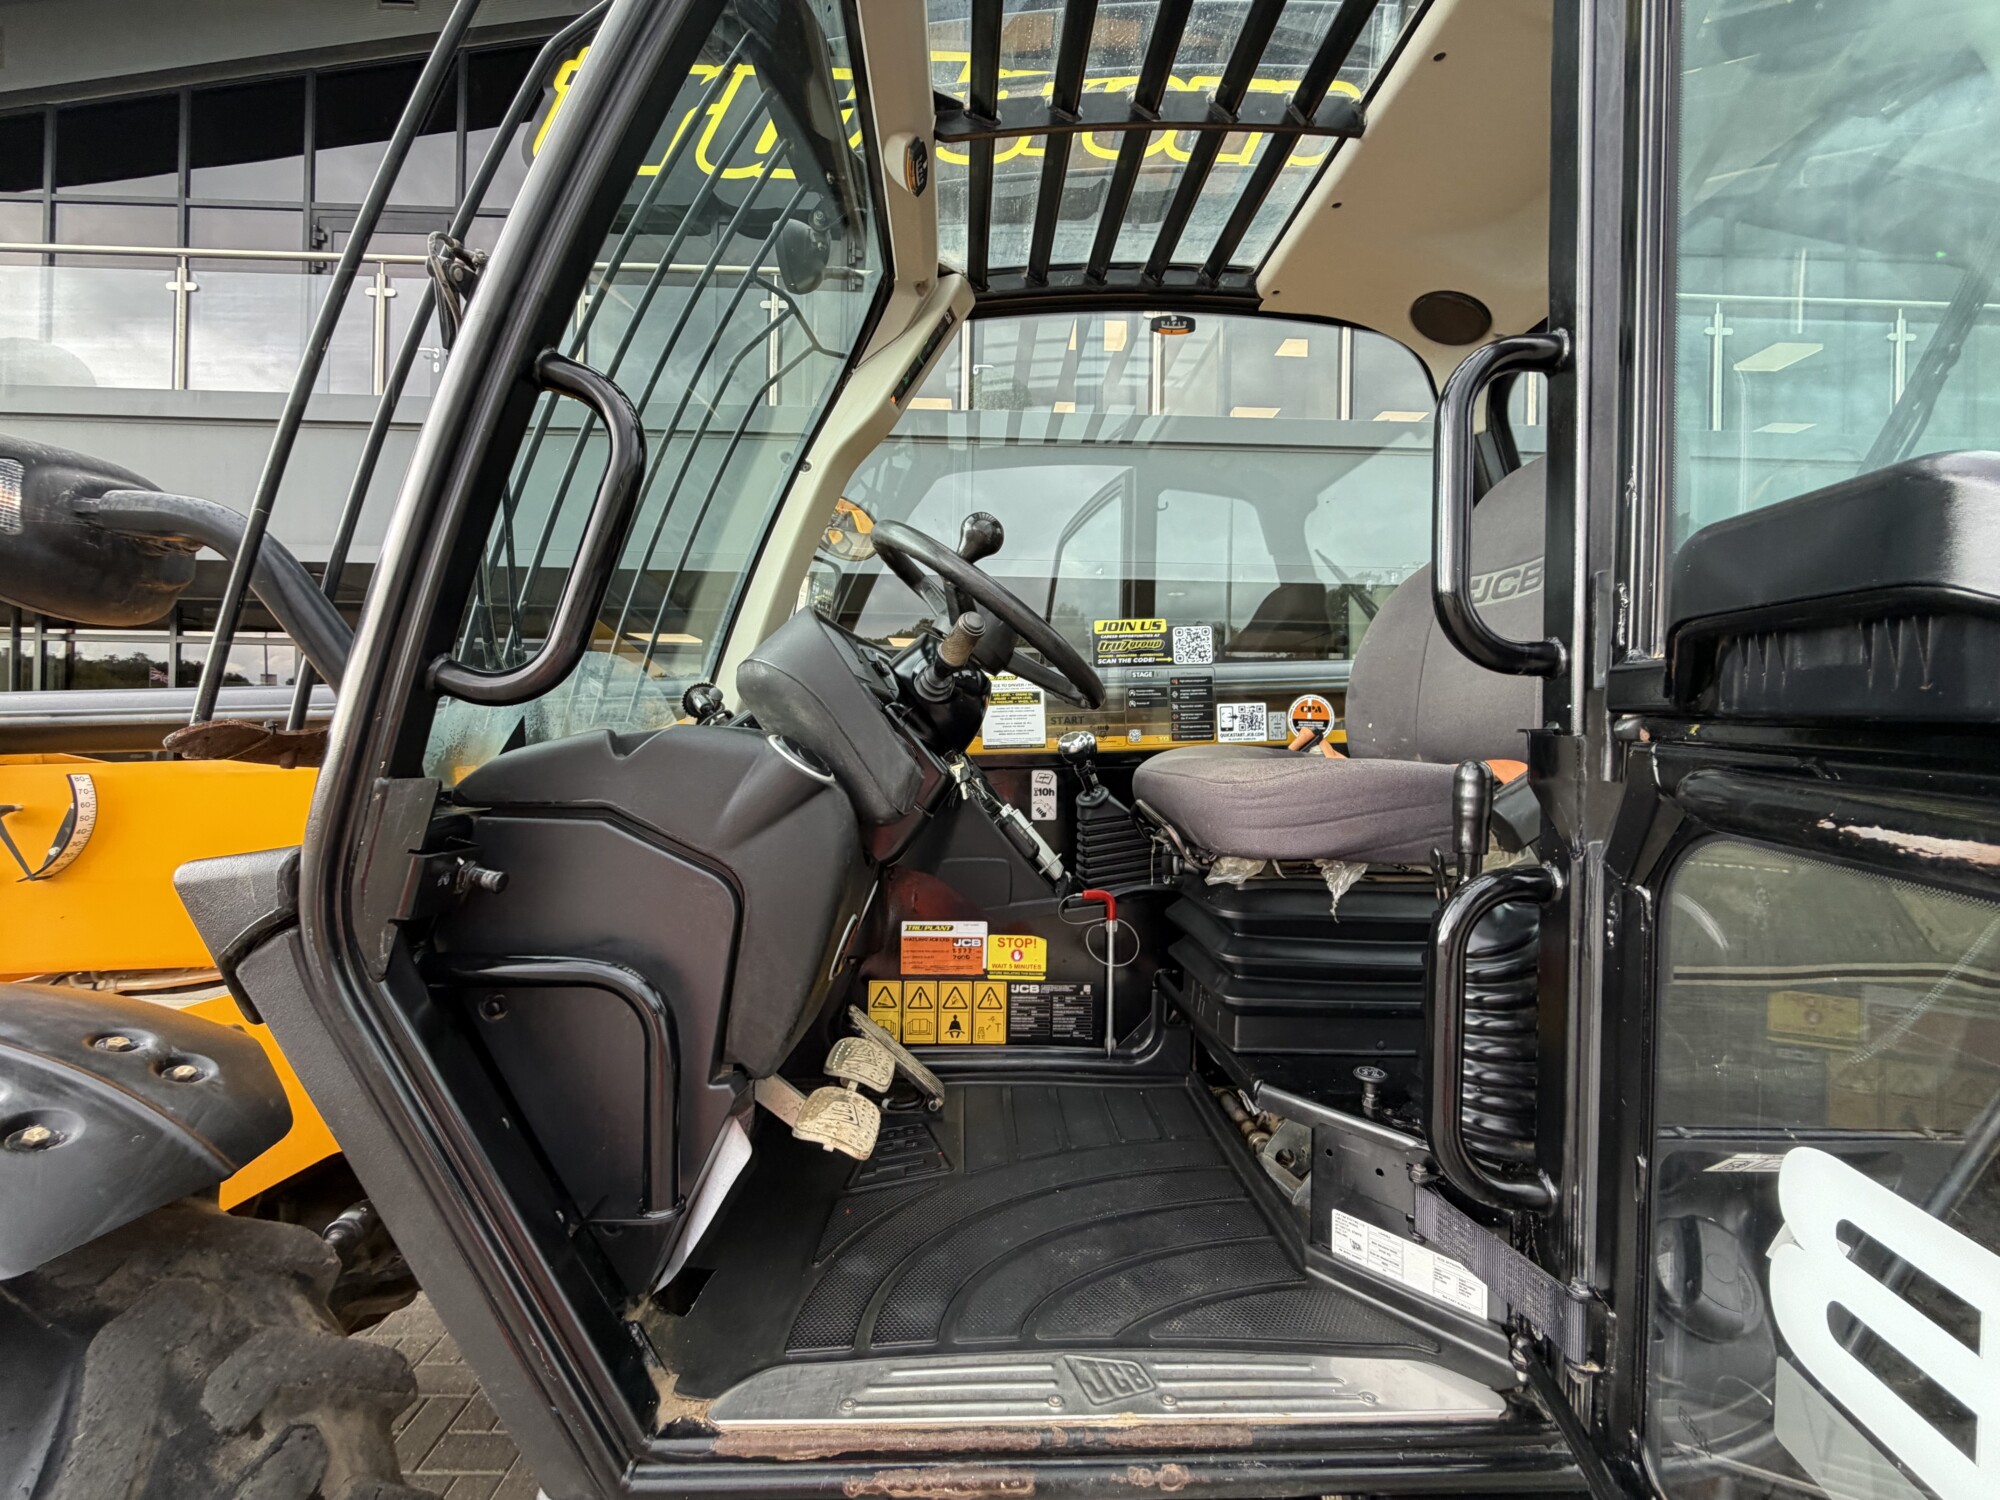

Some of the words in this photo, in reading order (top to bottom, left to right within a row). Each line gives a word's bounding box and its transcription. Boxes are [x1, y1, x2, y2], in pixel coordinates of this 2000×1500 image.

[1470, 559, 1544, 604] JCB
[1098, 621, 1136, 632] JOIN
[1140, 620, 1162, 631] US
[1051, 716, 1085, 724] START
[998, 937, 1037, 948] STOP!
[1011, 984, 1039, 993] JCB
[1077, 1358, 1152, 1401] JCB
